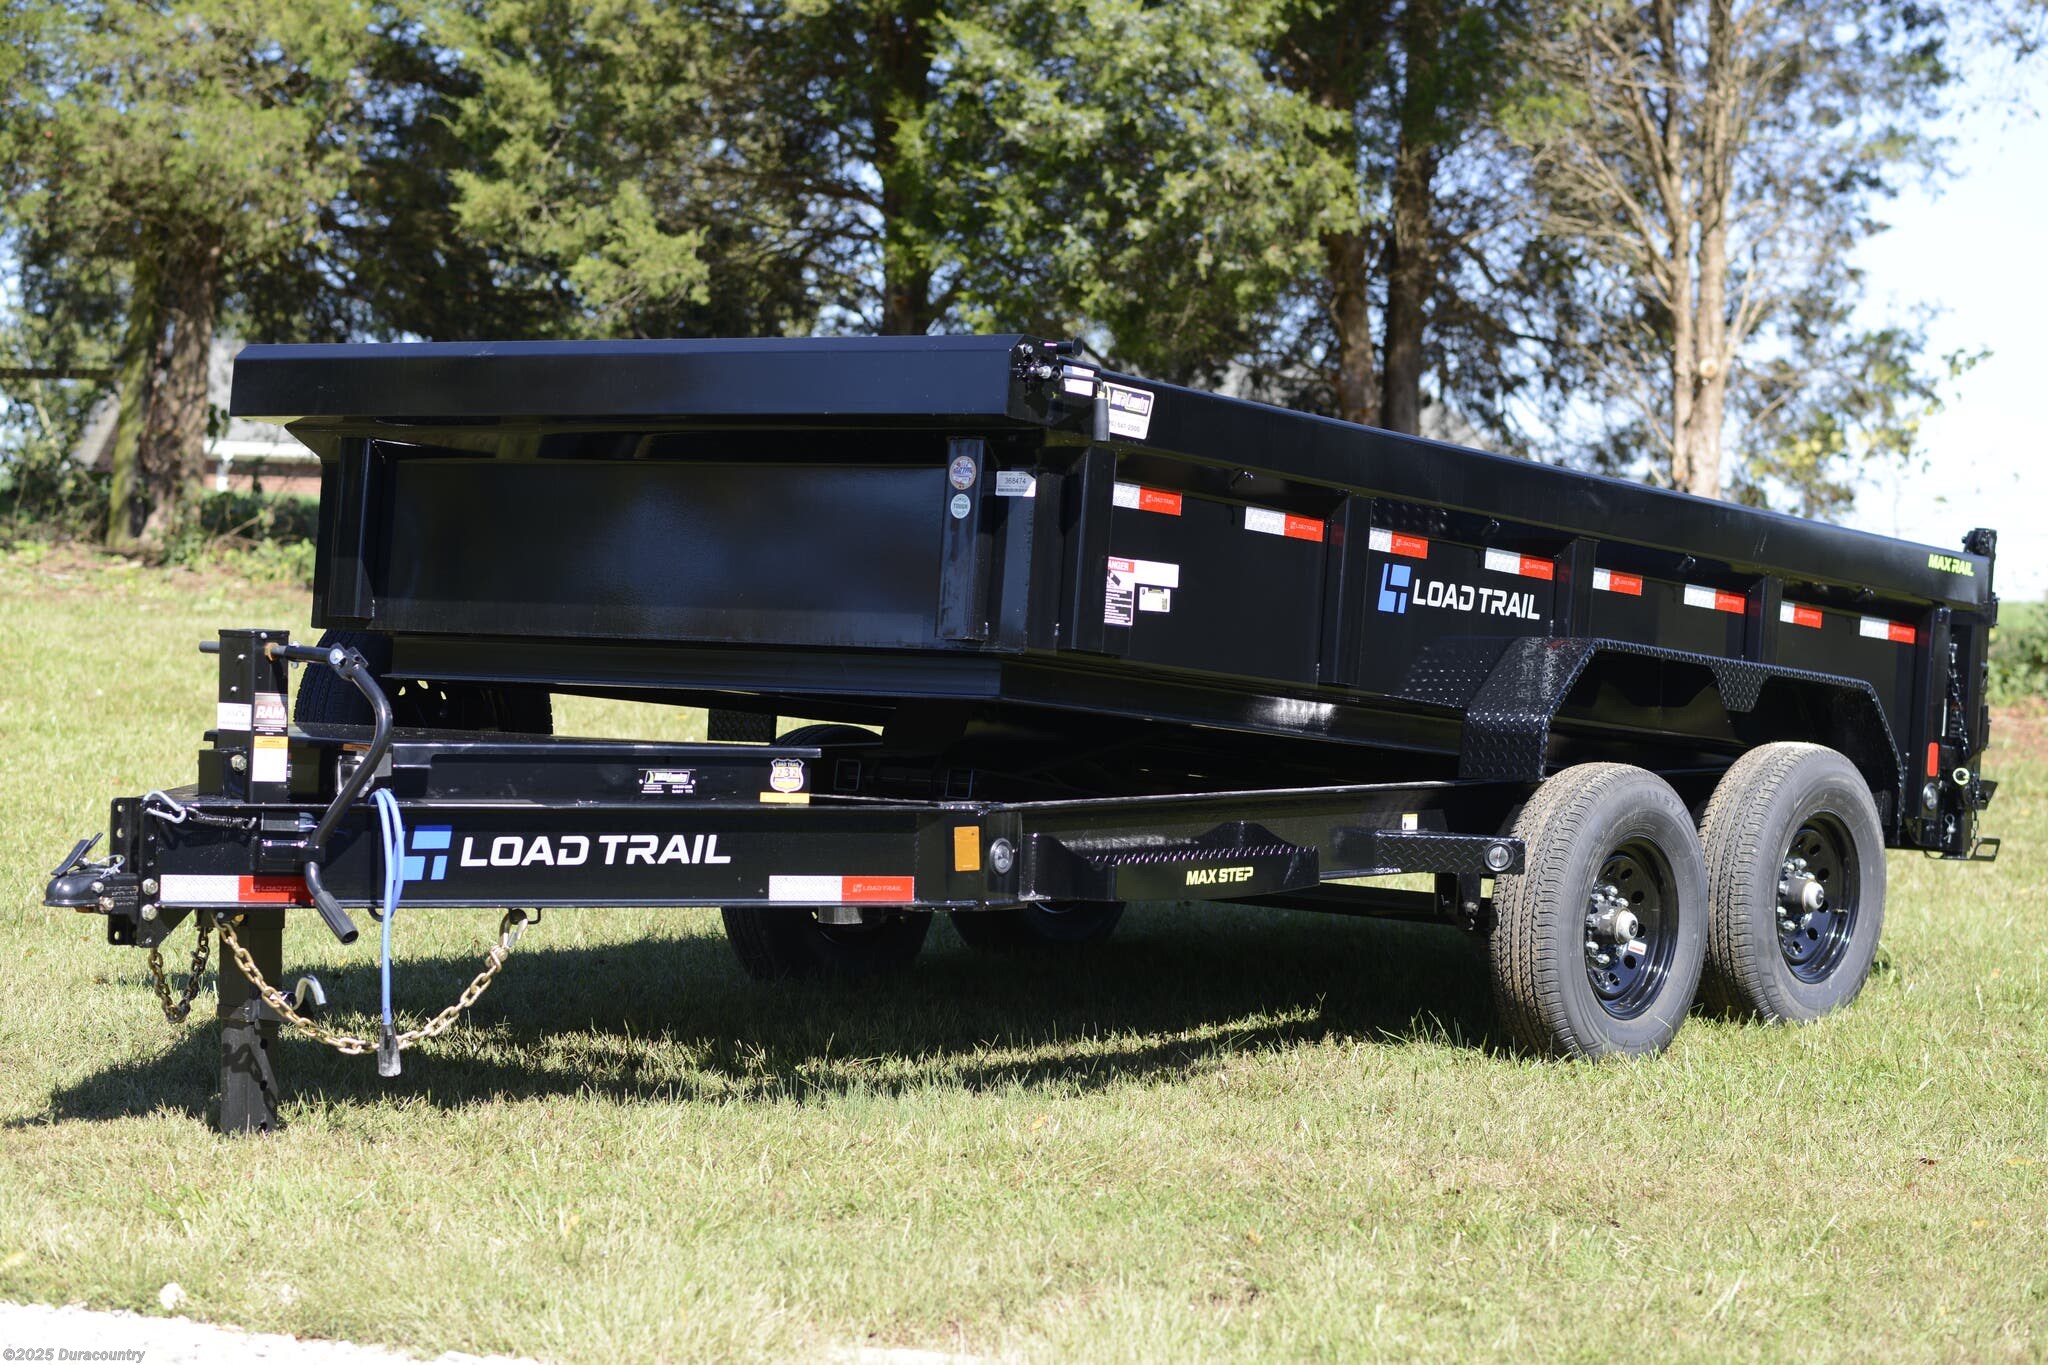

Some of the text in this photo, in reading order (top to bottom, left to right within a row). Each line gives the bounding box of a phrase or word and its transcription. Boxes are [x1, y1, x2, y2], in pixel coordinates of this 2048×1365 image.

[1107, 560, 1129, 571] ANGER
[1928, 553, 1974, 577] MAX RAIL
[1412, 578, 1541, 620] LOAD TRAIL
[255, 705, 285, 719] RAM
[460, 834, 731, 867] LOAD TRAIL
[1185, 866, 1254, 886] MAX STEP
